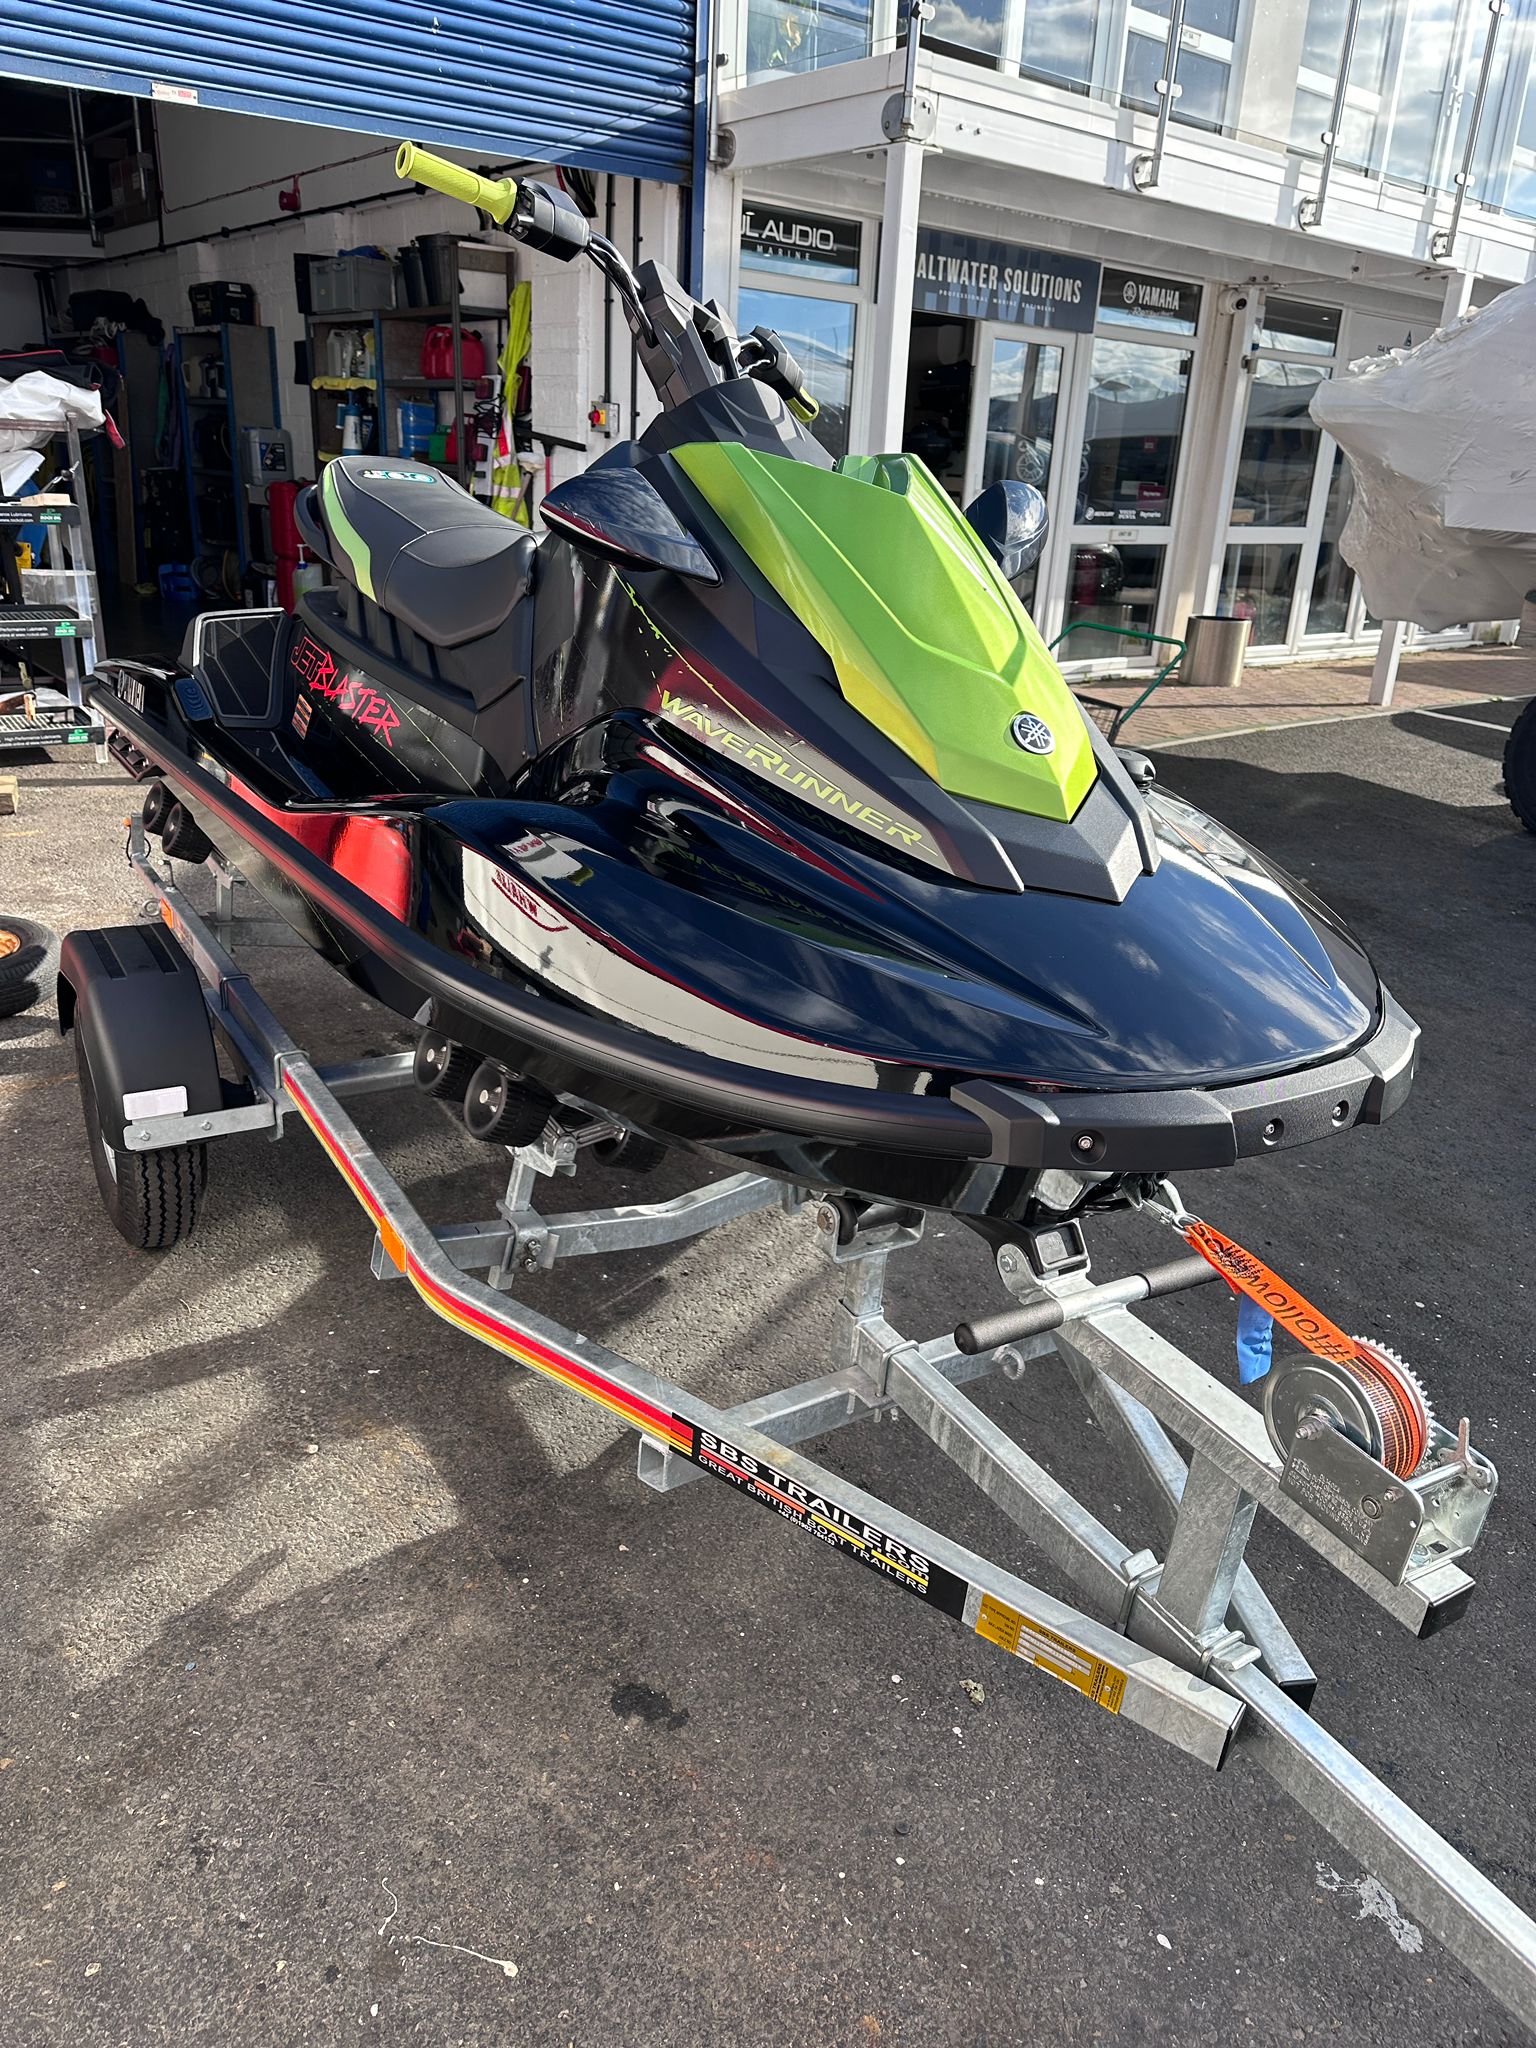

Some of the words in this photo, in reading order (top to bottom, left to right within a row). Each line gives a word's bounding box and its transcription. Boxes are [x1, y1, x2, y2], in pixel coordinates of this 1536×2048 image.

[756, 245, 811, 261] MARINE
[761, 219, 834, 250] AUDIO
[916, 252, 999, 290] ALTWATER
[1003, 267, 1082, 303] SOLUTIONS
[1138, 284, 1180, 310] YAMAHA
[661, 689, 922, 847] WAVERUNNER
[698, 1455, 744, 1485] GREAT
[747, 1483, 803, 1520] BRITISH
[807, 1518, 847, 1546] BOAT
[851, 1544, 927, 1594] TRAILERS
[700, 1432, 758, 1474] SBS
[768, 1469, 930, 1573] TRAILERS
